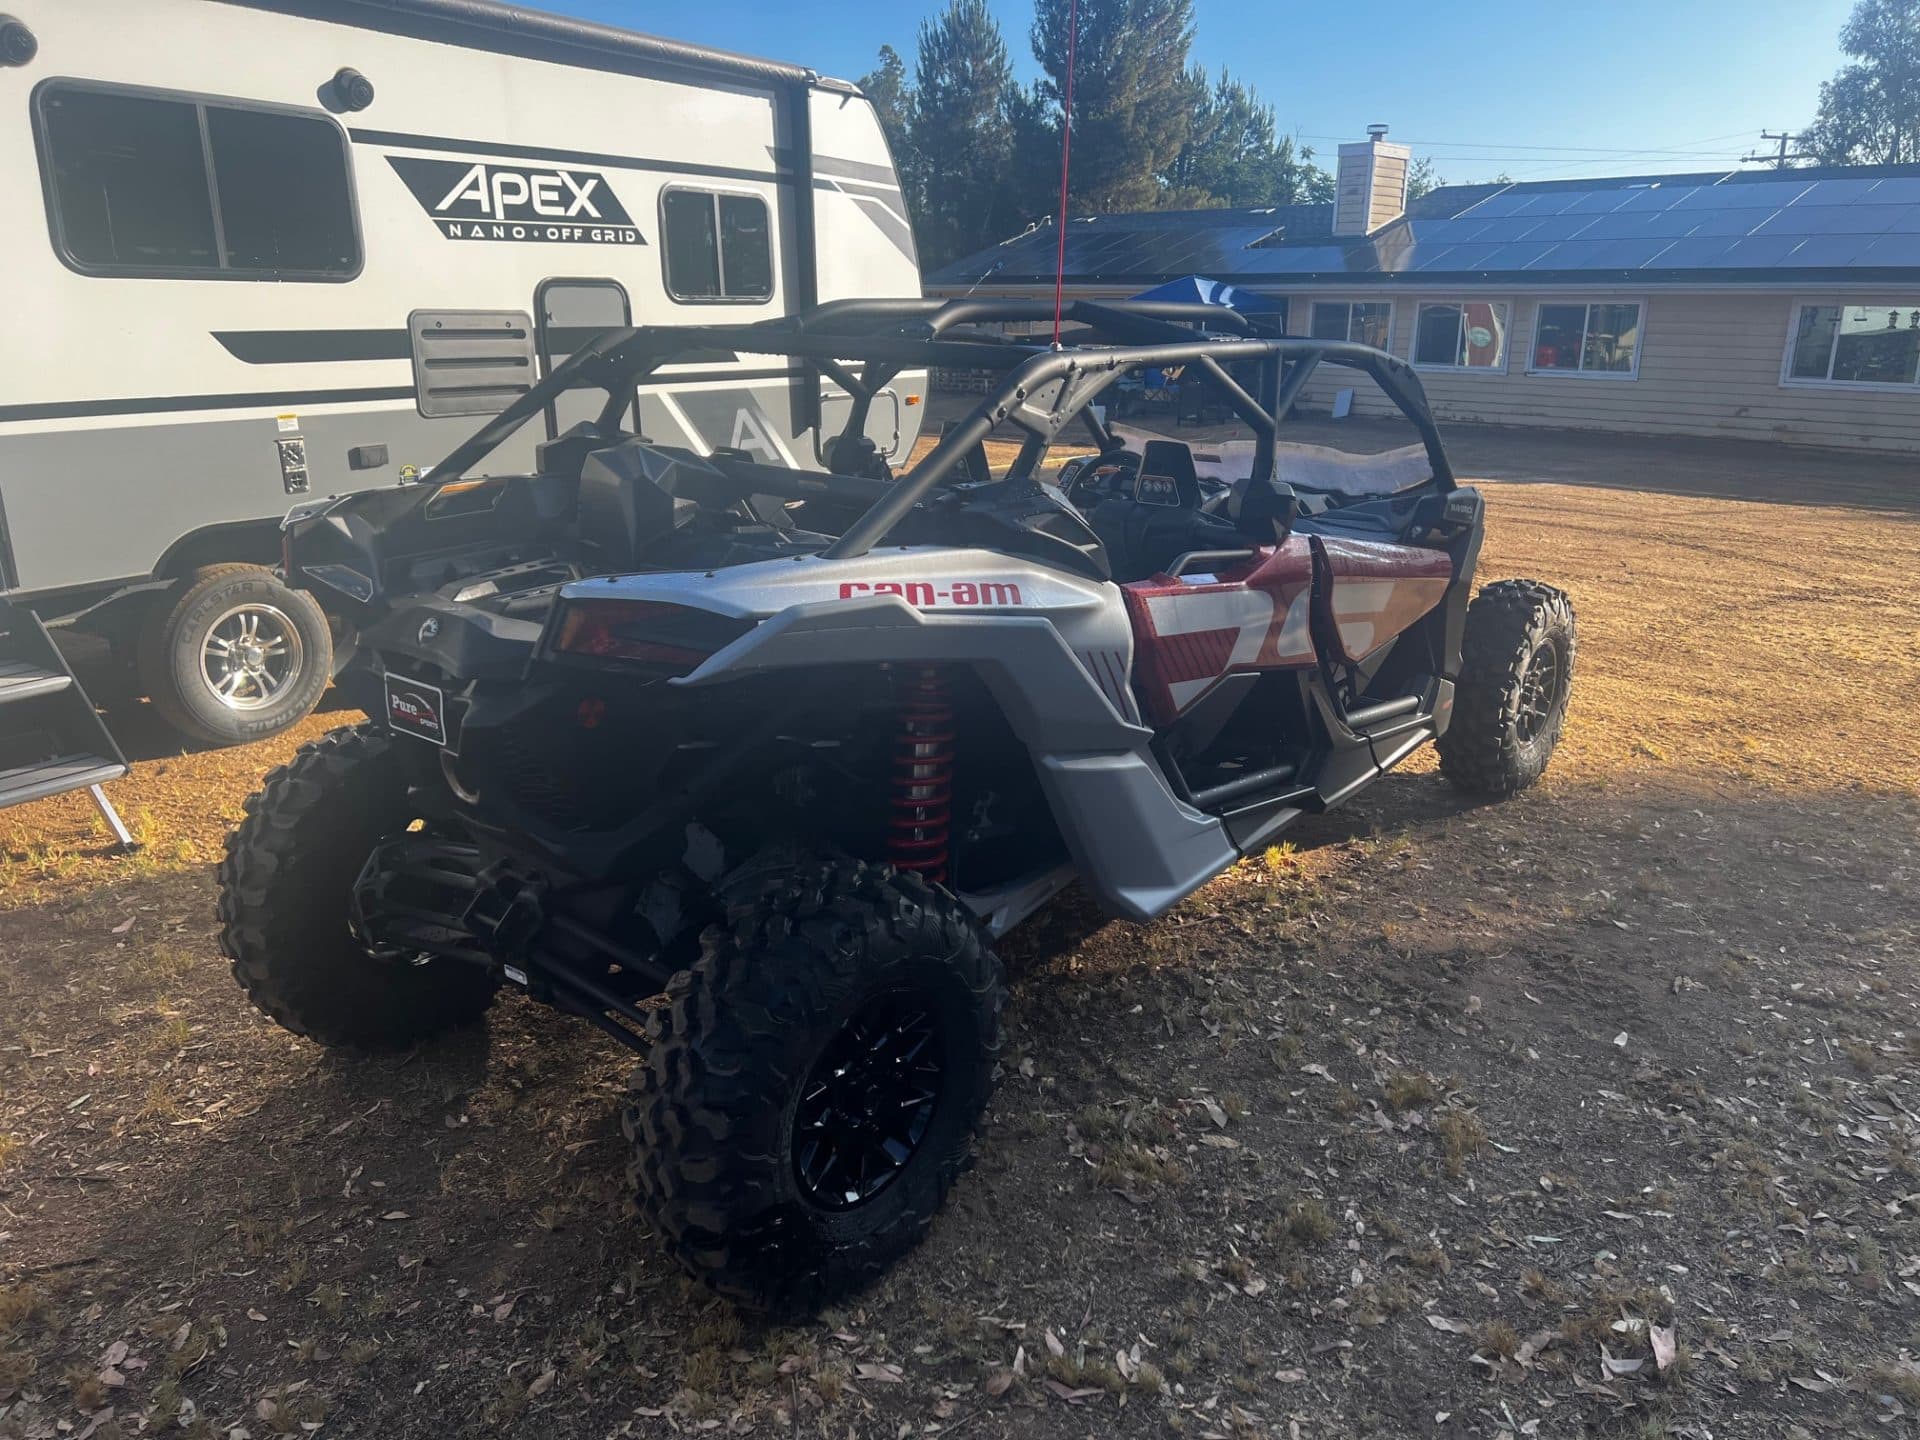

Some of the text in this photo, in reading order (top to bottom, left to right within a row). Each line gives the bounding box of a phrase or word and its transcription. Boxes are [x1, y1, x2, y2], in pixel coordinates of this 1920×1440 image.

[434, 164, 602, 220] APEX
[449, 223, 636, 242] NANO OFF GRID
[839, 582, 1022, 606] can-am
